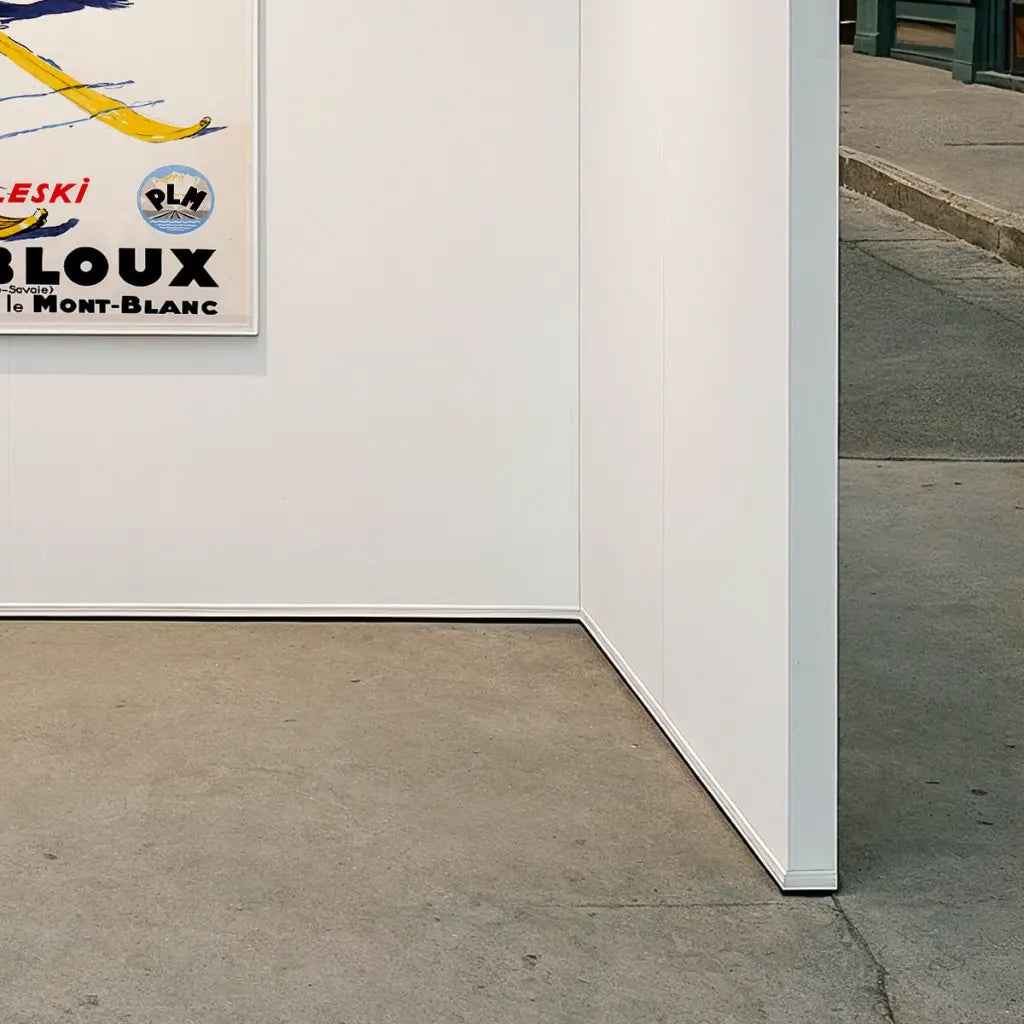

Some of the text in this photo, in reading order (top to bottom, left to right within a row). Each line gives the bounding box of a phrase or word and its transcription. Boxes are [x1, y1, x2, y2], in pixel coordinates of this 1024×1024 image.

[144, 183, 208, 212] PLM
[7, 295, 24, 313] le
[33, 294, 219, 316] MONT-BLANC
